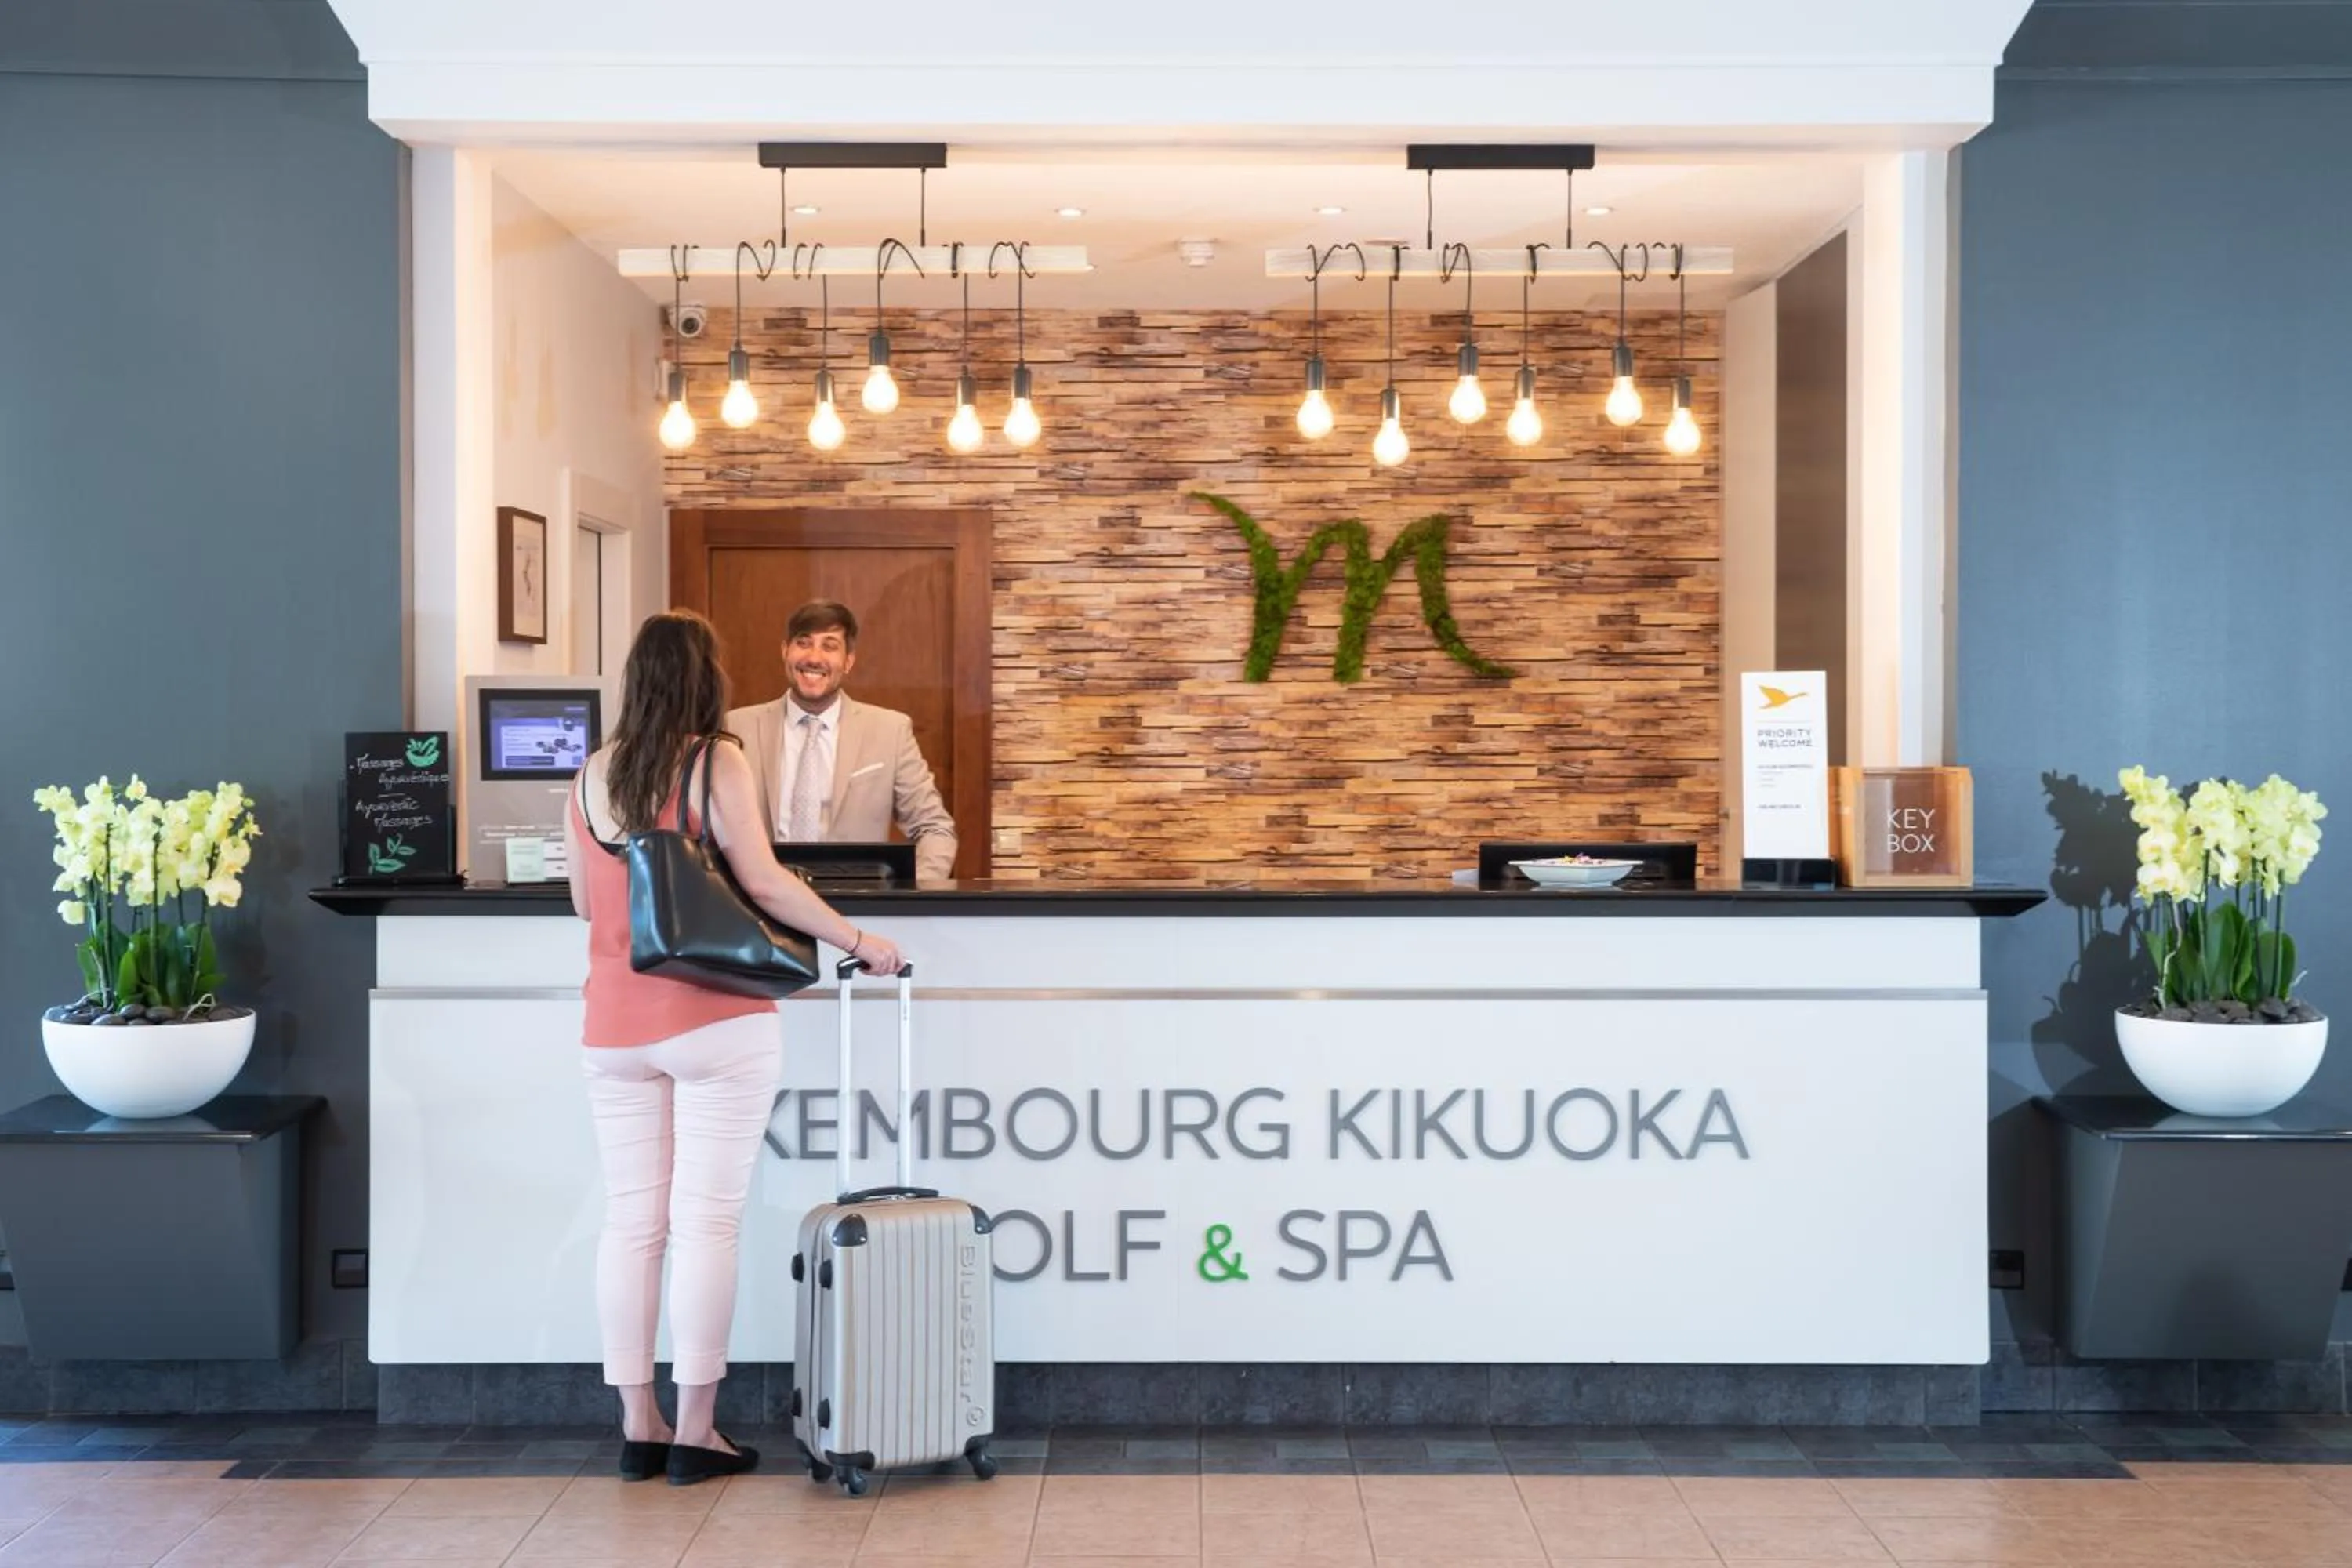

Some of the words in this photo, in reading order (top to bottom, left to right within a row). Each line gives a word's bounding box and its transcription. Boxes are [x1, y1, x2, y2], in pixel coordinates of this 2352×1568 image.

[1757, 728, 1811, 738] PRIORITY
[1757, 739, 1813, 748] WELCOME
[1887, 808, 1936, 829] KEY
[1887, 833, 1936, 854] BOX
[764, 1087, 1290, 1161] EMBOURG
[1329, 1087, 1751, 1161] KIKUOKA
[991, 1209, 1166, 1282] OLF
[1197, 1223, 1250, 1283] &
[1276, 1208, 1455, 1283] SPA
